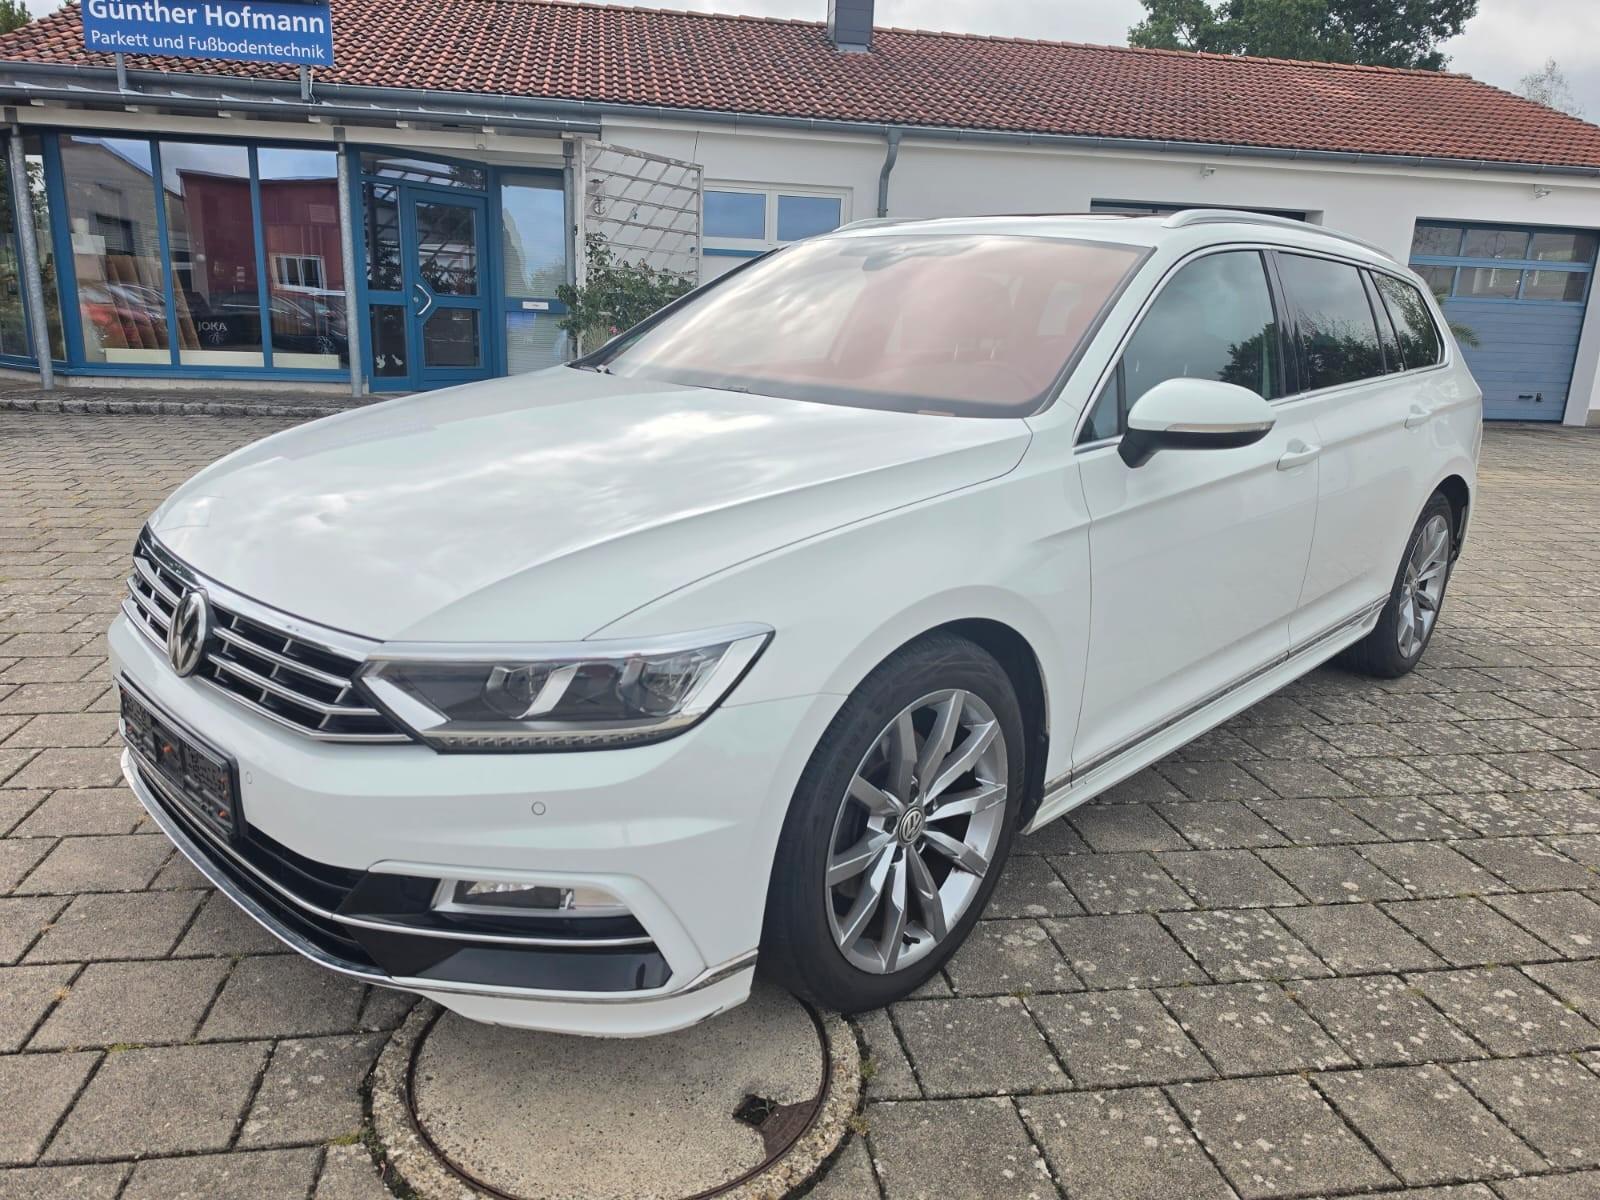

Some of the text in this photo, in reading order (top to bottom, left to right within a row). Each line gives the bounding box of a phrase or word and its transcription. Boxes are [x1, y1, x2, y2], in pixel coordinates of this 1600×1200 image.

[88, 0, 325, 34] Günther Hofmann
[91, 30, 325, 59] Parkett und Fußbodentechnik
[197, 321, 228, 331] JOKA
